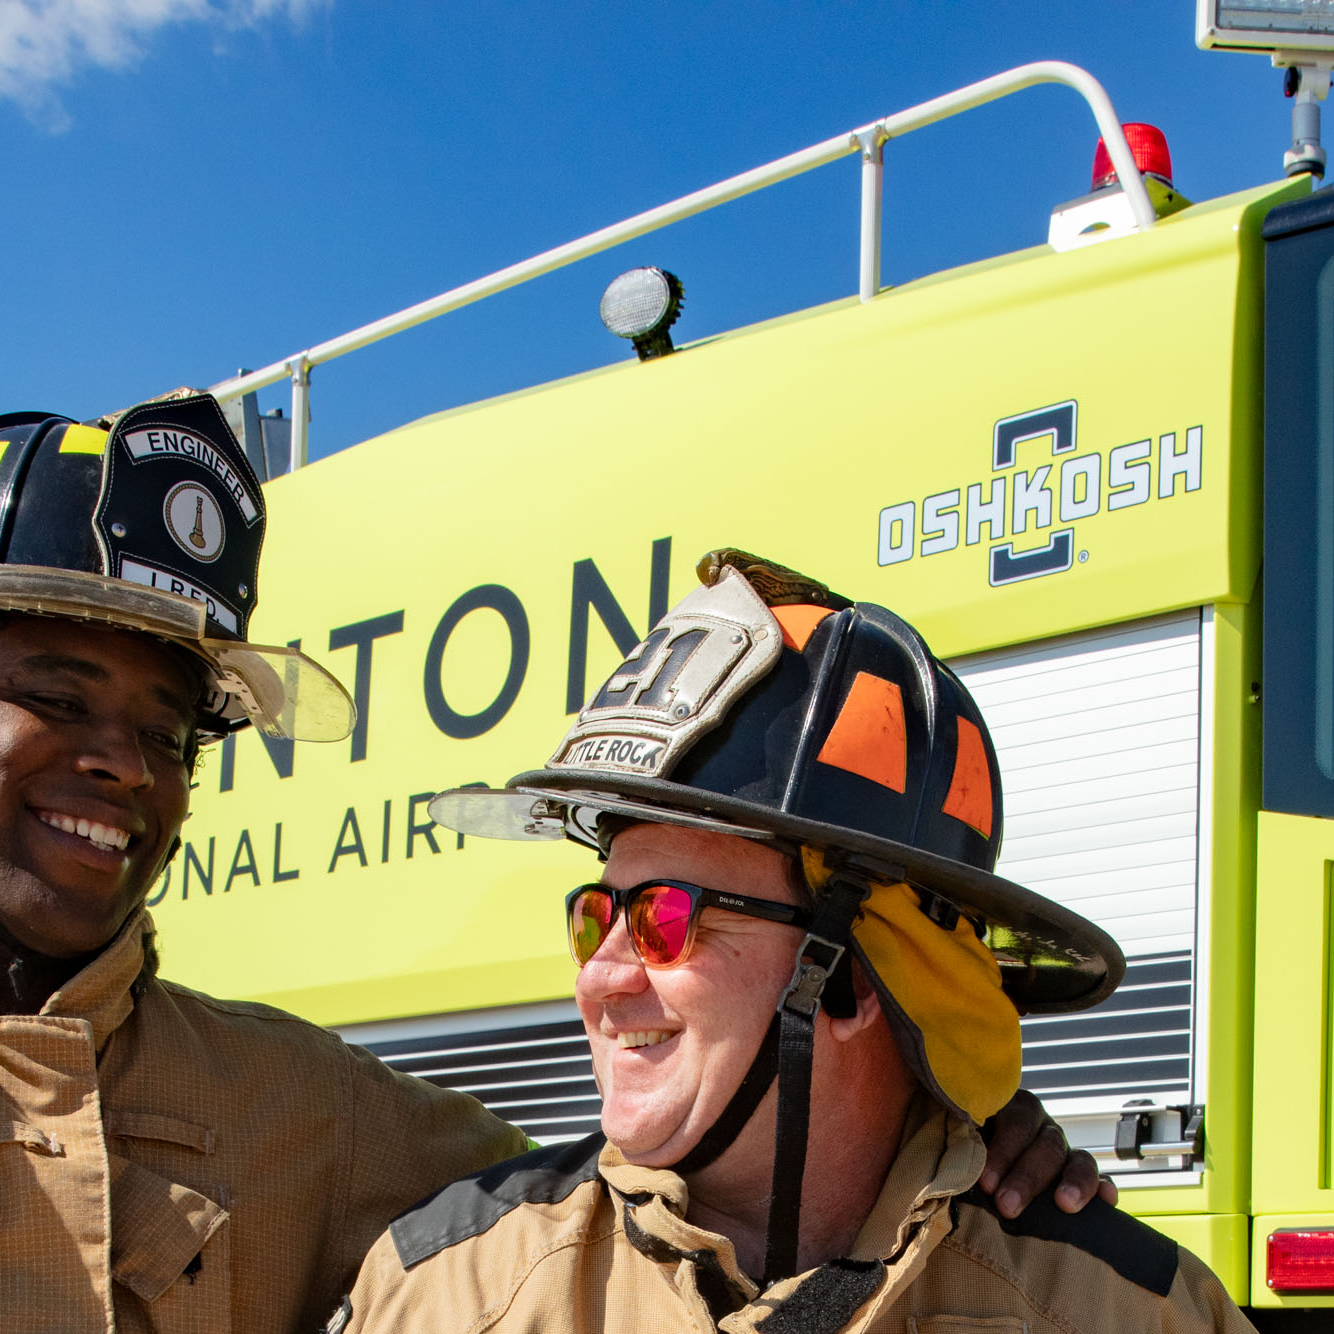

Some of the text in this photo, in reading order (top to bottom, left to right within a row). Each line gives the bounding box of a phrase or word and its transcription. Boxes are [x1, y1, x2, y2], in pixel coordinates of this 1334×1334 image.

[147, 431, 245, 504] ENGINEER
[877, 425, 1204, 568] OSHKOSH
[563, 739, 664, 769] LITTLE ROCK
